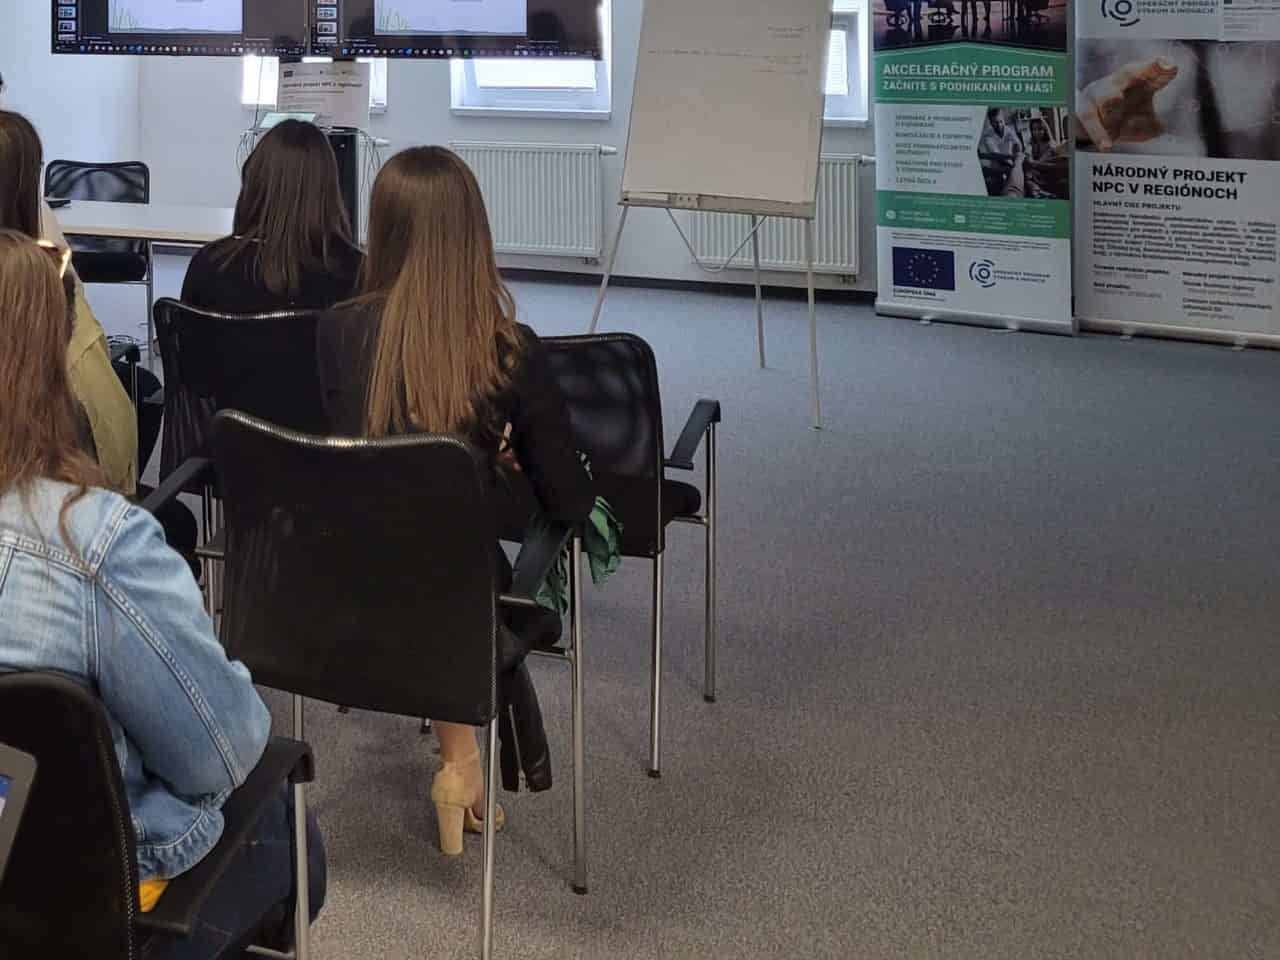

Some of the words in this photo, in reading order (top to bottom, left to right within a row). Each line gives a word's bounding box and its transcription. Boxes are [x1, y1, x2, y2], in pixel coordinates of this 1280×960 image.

[882, 62, 978, 76] AKCELERAČNÝ
[982, 64, 1054, 77] PROGRAM
[883, 79, 927, 90] ZAČNITE
[930, 81, 937, 90] S
[939, 81, 1011, 91] PODNIKANÍM
[1014, 83, 1022, 92] U
[1025, 82, 1054, 93] NÁS!
[1092, 163, 1168, 179] NÁRODNÝ
[1173, 169, 1248, 184] PROJEKT
[1092, 181, 1125, 194] NPC
[1127, 183, 1140, 194] V
[1143, 184, 1238, 200] REGIÓNOCH
